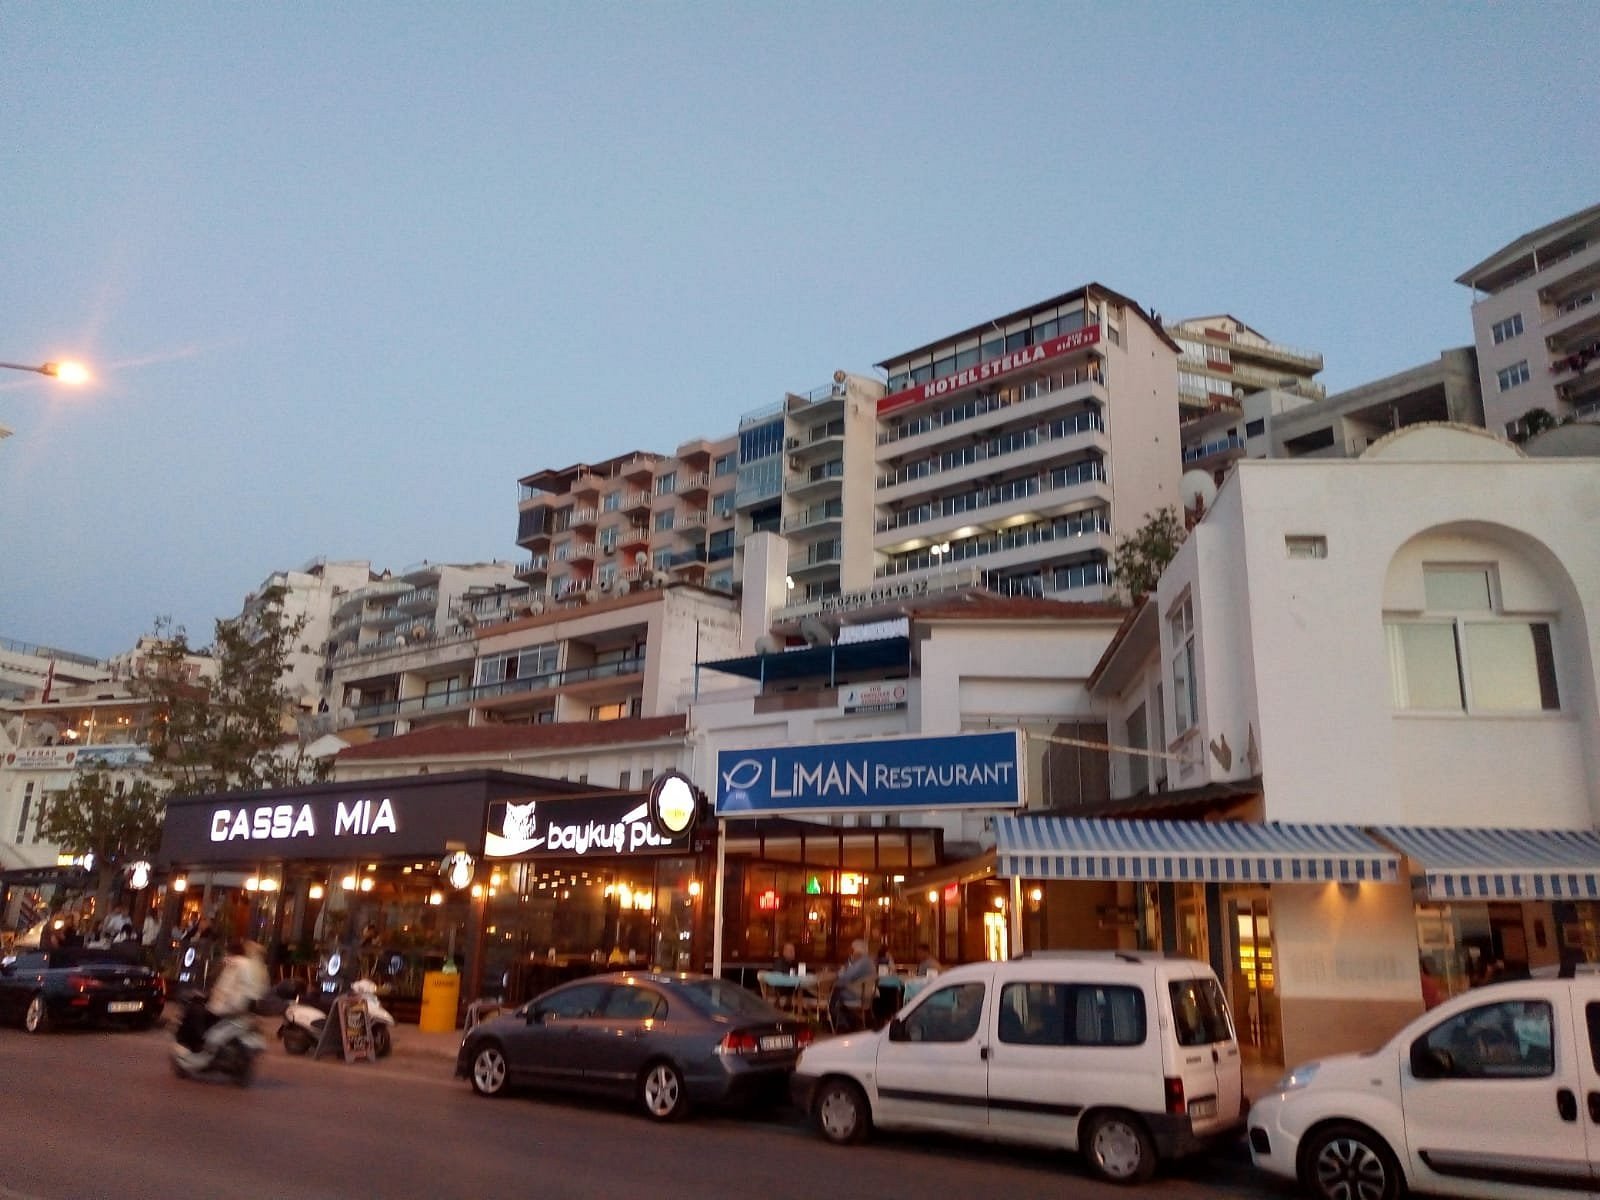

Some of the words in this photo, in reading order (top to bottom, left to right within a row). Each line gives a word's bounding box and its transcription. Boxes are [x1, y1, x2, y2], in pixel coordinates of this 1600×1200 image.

[924, 368, 978, 398] HOTEL
[981, 346, 1046, 379] STELLA
[876, 761, 1014, 789] RESTAURANT
[210, 804, 315, 841] CASSA
[334, 798, 397, 836] MIA
[630, 821, 672, 852] pu
